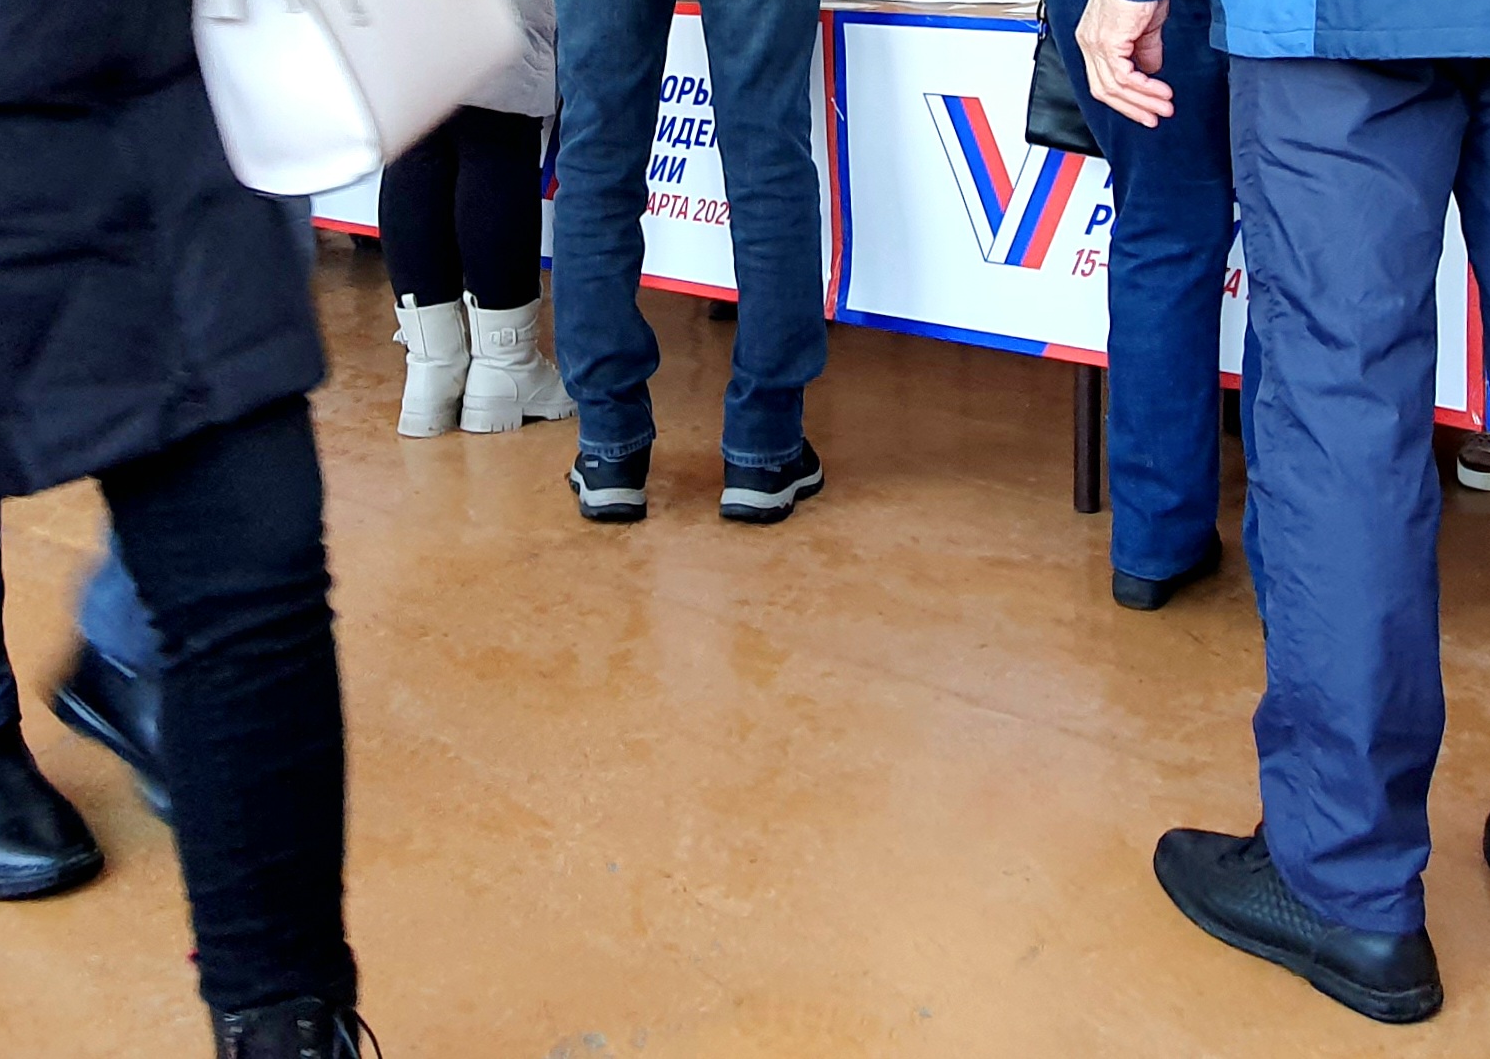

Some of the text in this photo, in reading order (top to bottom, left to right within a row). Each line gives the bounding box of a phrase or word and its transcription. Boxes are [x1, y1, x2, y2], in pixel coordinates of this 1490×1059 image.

[646, 191, 731, 226] АРТА 202
[1071, 247, 1110, 278] 15-
